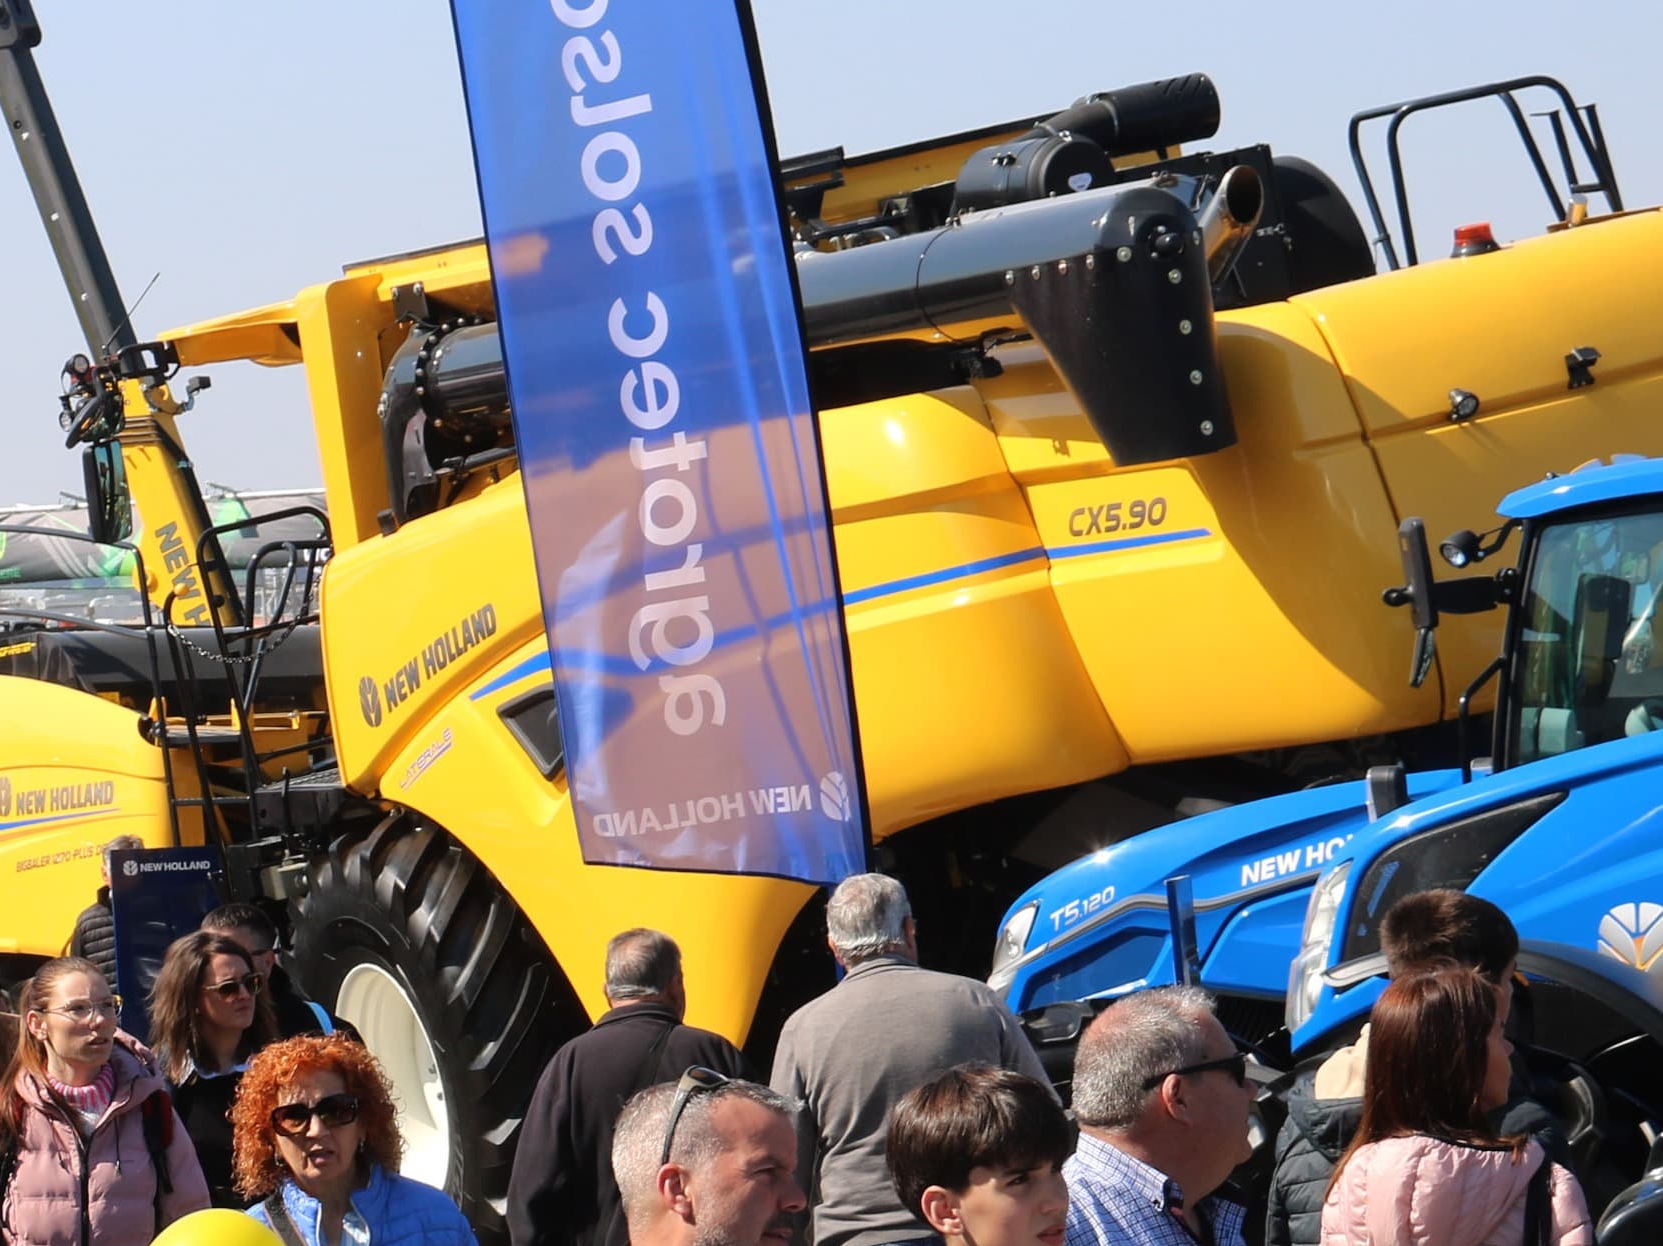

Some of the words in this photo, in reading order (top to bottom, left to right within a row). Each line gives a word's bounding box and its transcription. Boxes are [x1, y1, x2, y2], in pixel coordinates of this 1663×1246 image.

[1069, 496, 1167, 537] CX5.90
[383, 656, 421, 713] NEW
[422, 603, 497, 680] HOLLAND
[16, 788, 46, 816] NEW
[50, 781, 114, 812] HOLLAND
[140, 863, 164, 873] NEW
[164, 861, 211, 871] HOLLAND
[1241, 849, 1301, 887] NEW
[1049, 886, 1116, 933] T5.120
